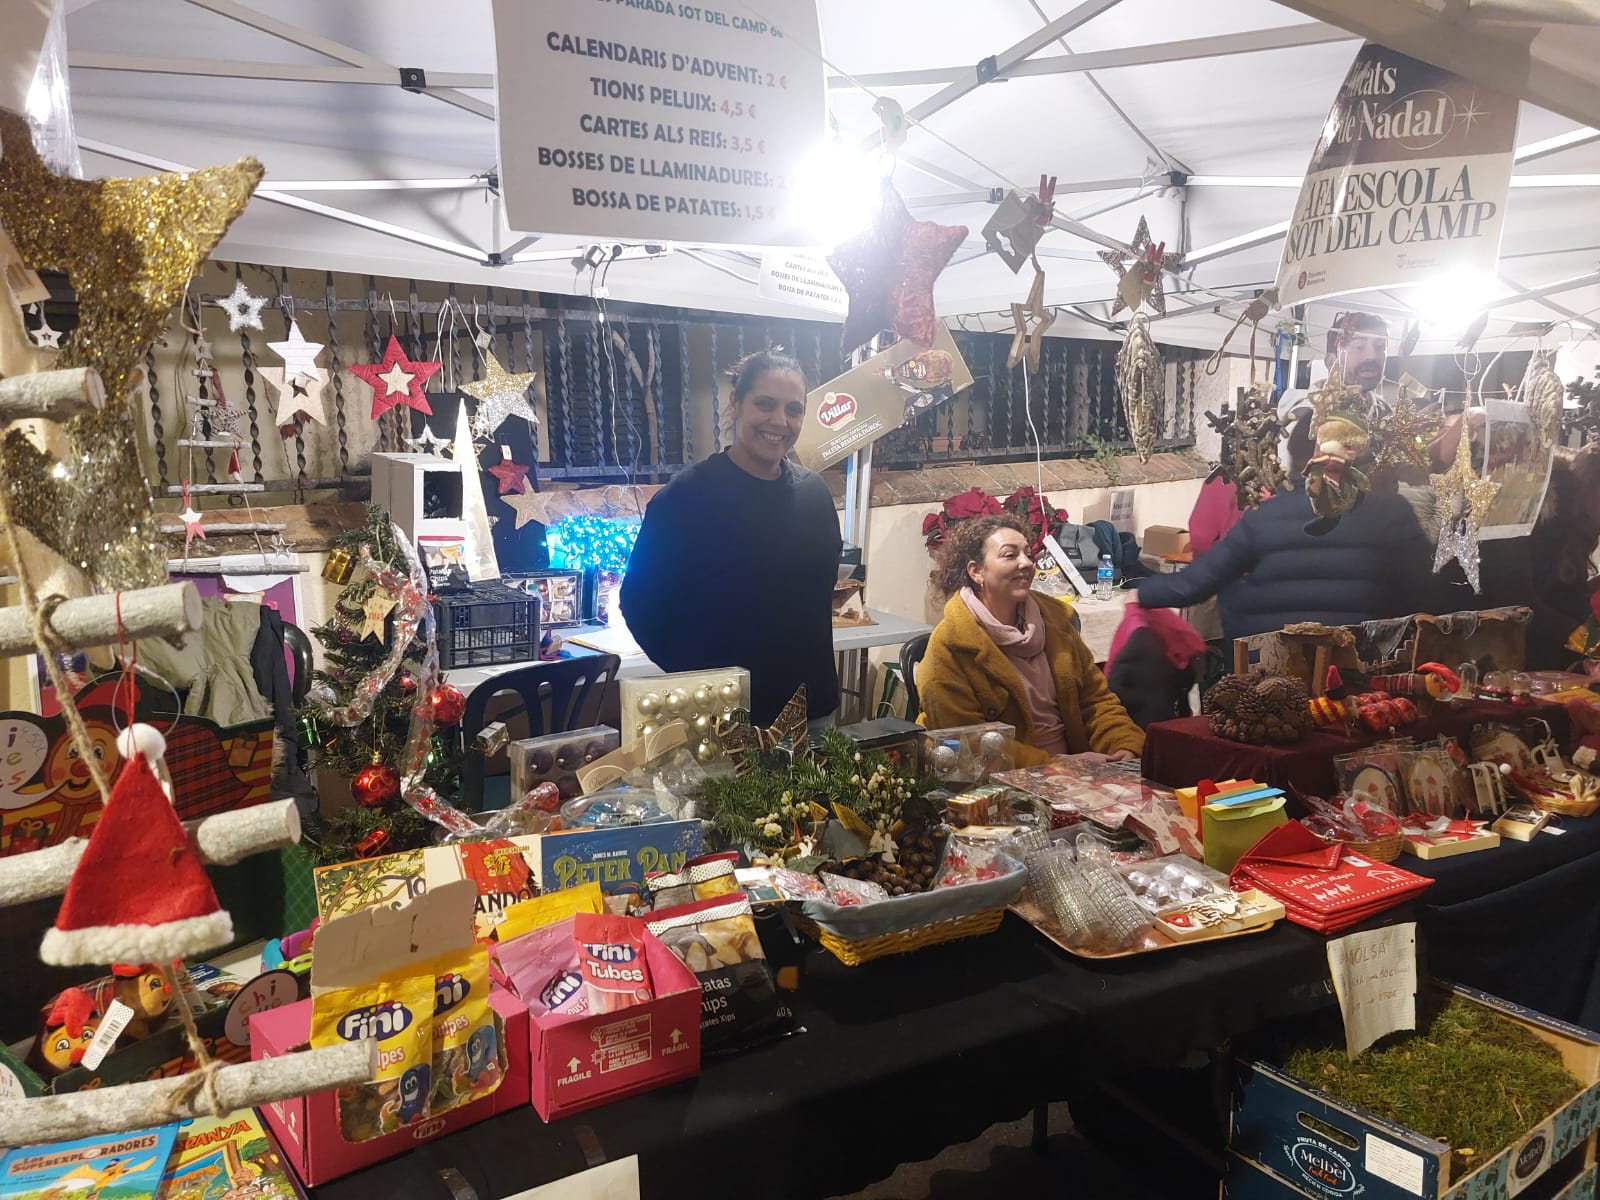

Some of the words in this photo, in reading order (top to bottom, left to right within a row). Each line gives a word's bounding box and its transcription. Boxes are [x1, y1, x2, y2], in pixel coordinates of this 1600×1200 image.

[678, 4, 701, 21] SOT
[705, 10, 729, 27] DEL
[732, 16, 768, 34] CAMP
[546, 31, 667, 69] CALENDARIS
[672, 53, 762, 86] D'ADVENT:
[766, 73, 776, 88] 2
[590, 77, 644, 103] TIONS
[650, 86, 716, 112] PELUIX:
[720, 100, 744, 119] 4,5
[580, 114, 648, 140] CARTES
[654, 124, 684, 144] ALS
[689, 129, 727, 150] REIS:
[731, 136, 753, 154] 3,5
[1357, 97, 1447, 141] Nadal
[537, 146, 605, 172] BOSSES
[610, 155, 635, 174] DE
[640, 158, 774, 189] LLAMINADURES:
[572, 188, 632, 211] BOSSA
[636, 193, 661, 213] DE
[664, 196, 742, 219] PATATES:
[1300, 176, 1337, 221] AFA
[1341, 164, 1475, 214] ESCOLA
[1285, 218, 1324, 265] SOT
[1328, 211, 1383, 253] DEL
[1388, 201, 1497, 245] CAMP
[821, 400, 852, 423] Villar
[553, 855, 632, 888] PETER
[637, 846, 688, 876] PAN
[1284, 873, 1320, 888] CARTA
[1328, 872, 1355, 884] Magos
[592, 944, 632, 962] Fini
[586, 960, 644, 982] Tubes
[344, 1001, 405, 1040] Fini
[557, 1069, 592, 1088] FRAGILE
[11, 1135, 157, 1173] SUPEREXPLRADORES
[1297, 1136, 1318, 1146] FRUTA
[1318, 1141, 1330, 1151] DE
[1328, 1146, 1351, 1168] CAMPO
[1300, 1149, 1346, 1182] Melbel
